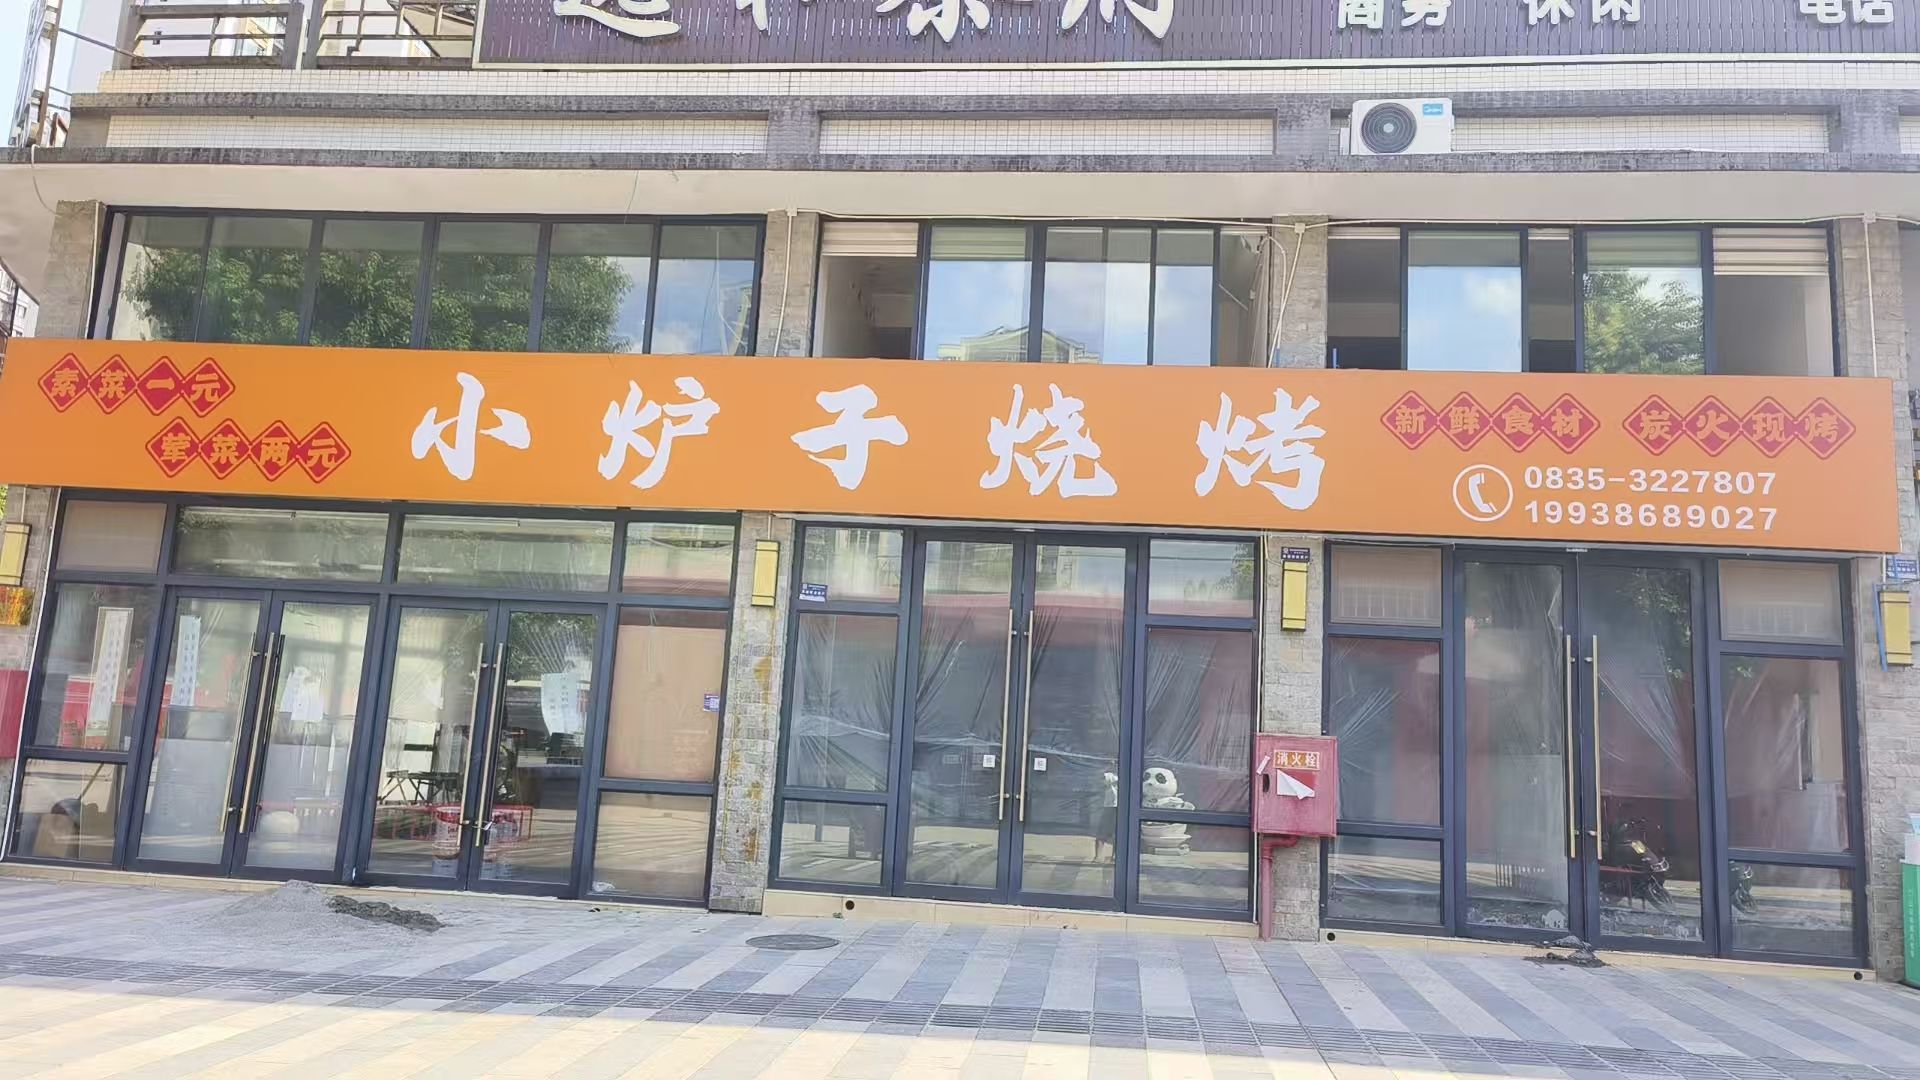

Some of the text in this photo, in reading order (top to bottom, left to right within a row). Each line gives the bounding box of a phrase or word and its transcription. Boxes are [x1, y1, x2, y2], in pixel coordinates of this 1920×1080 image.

[51, 367, 221, 402] 素菜一元
[1394, 404, 1587, 438] 新鲜食材
[1639, 408, 1842, 443] 炭火现烤
[160, 432, 338, 469] 荤菜两元
[411, 372, 1327, 511] 小炉子烧烤
[1524, 466, 1777, 496] 0835-3227807
[1525, 500, 1778, 531] 19938689027
[1276, 751, 1317, 768] 消火栓
